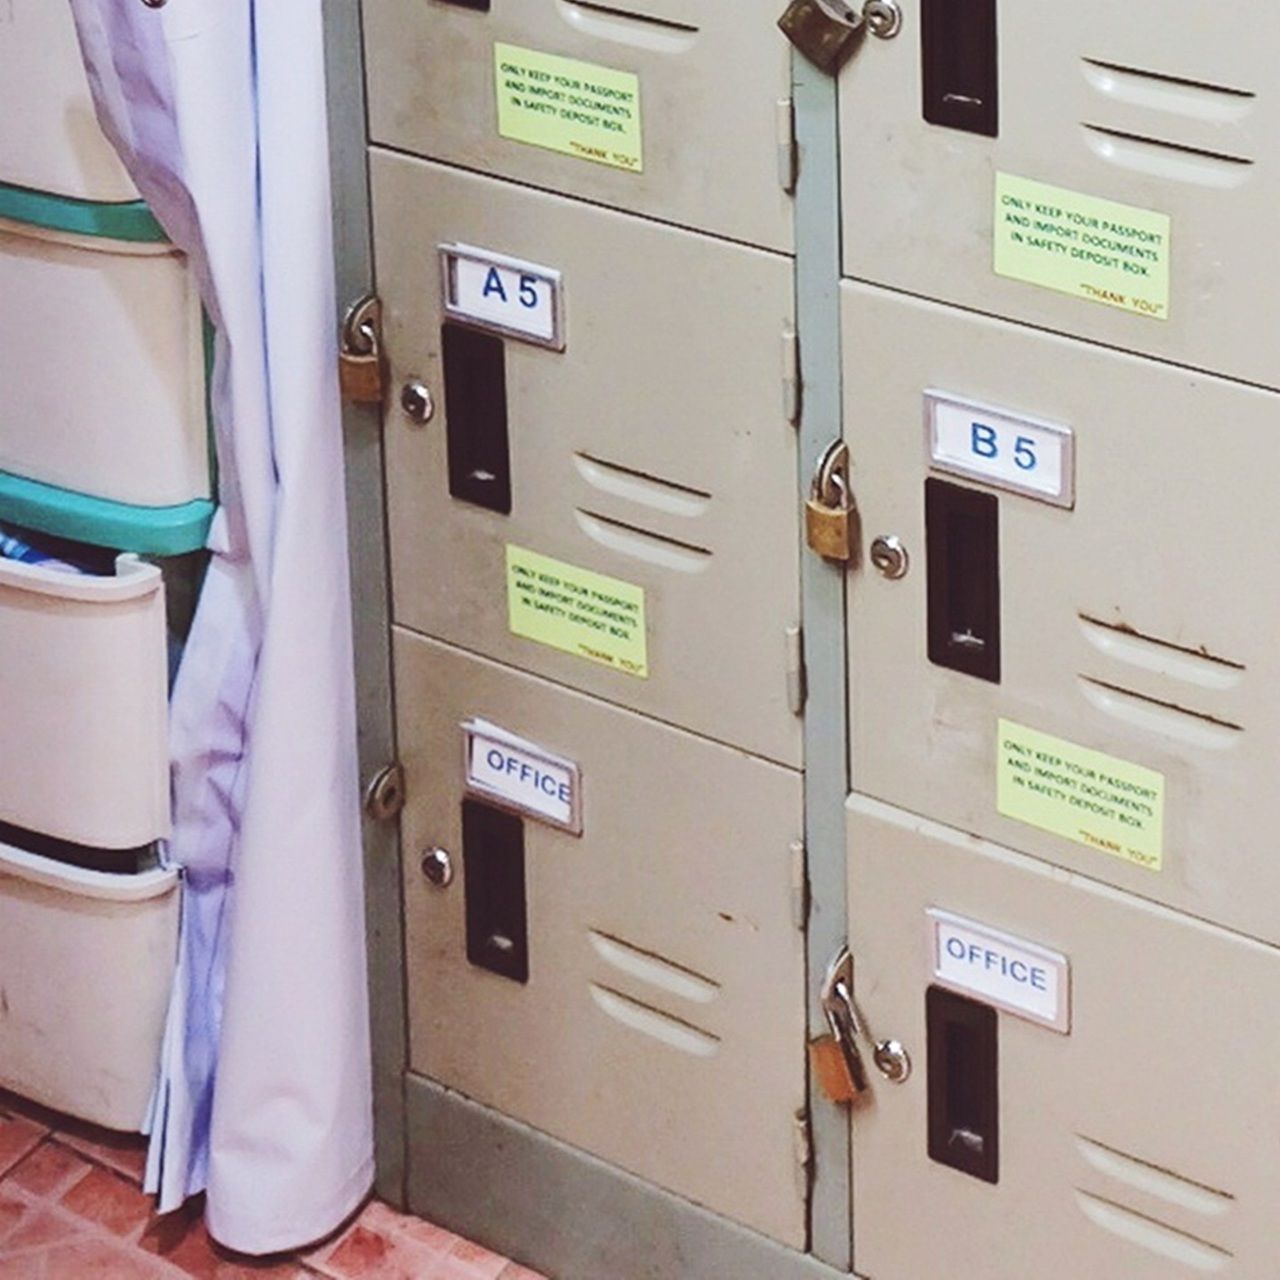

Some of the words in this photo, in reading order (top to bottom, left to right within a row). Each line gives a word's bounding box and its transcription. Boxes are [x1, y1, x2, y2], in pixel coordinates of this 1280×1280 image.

[1001, 194, 1031, 211] ONLY
[1035, 202, 1062, 219] KEEP
[1066, 211, 1098, 228] YOUR
[1102, 220, 1161, 245] PASSPORT
[1005, 212, 1029, 227] AND
[1034, 220, 1077, 240] IMPORT
[1082, 232, 1158, 261] DOCUMENTS
[1010, 230, 1023, 243] IN
[1026, 234, 1067, 255] SAFETY
[1070, 246, 1118, 268] DEPOSIT
[486, 748, 572, 805] OFFICE
[943, 937, 1045, 993] OFFICE
